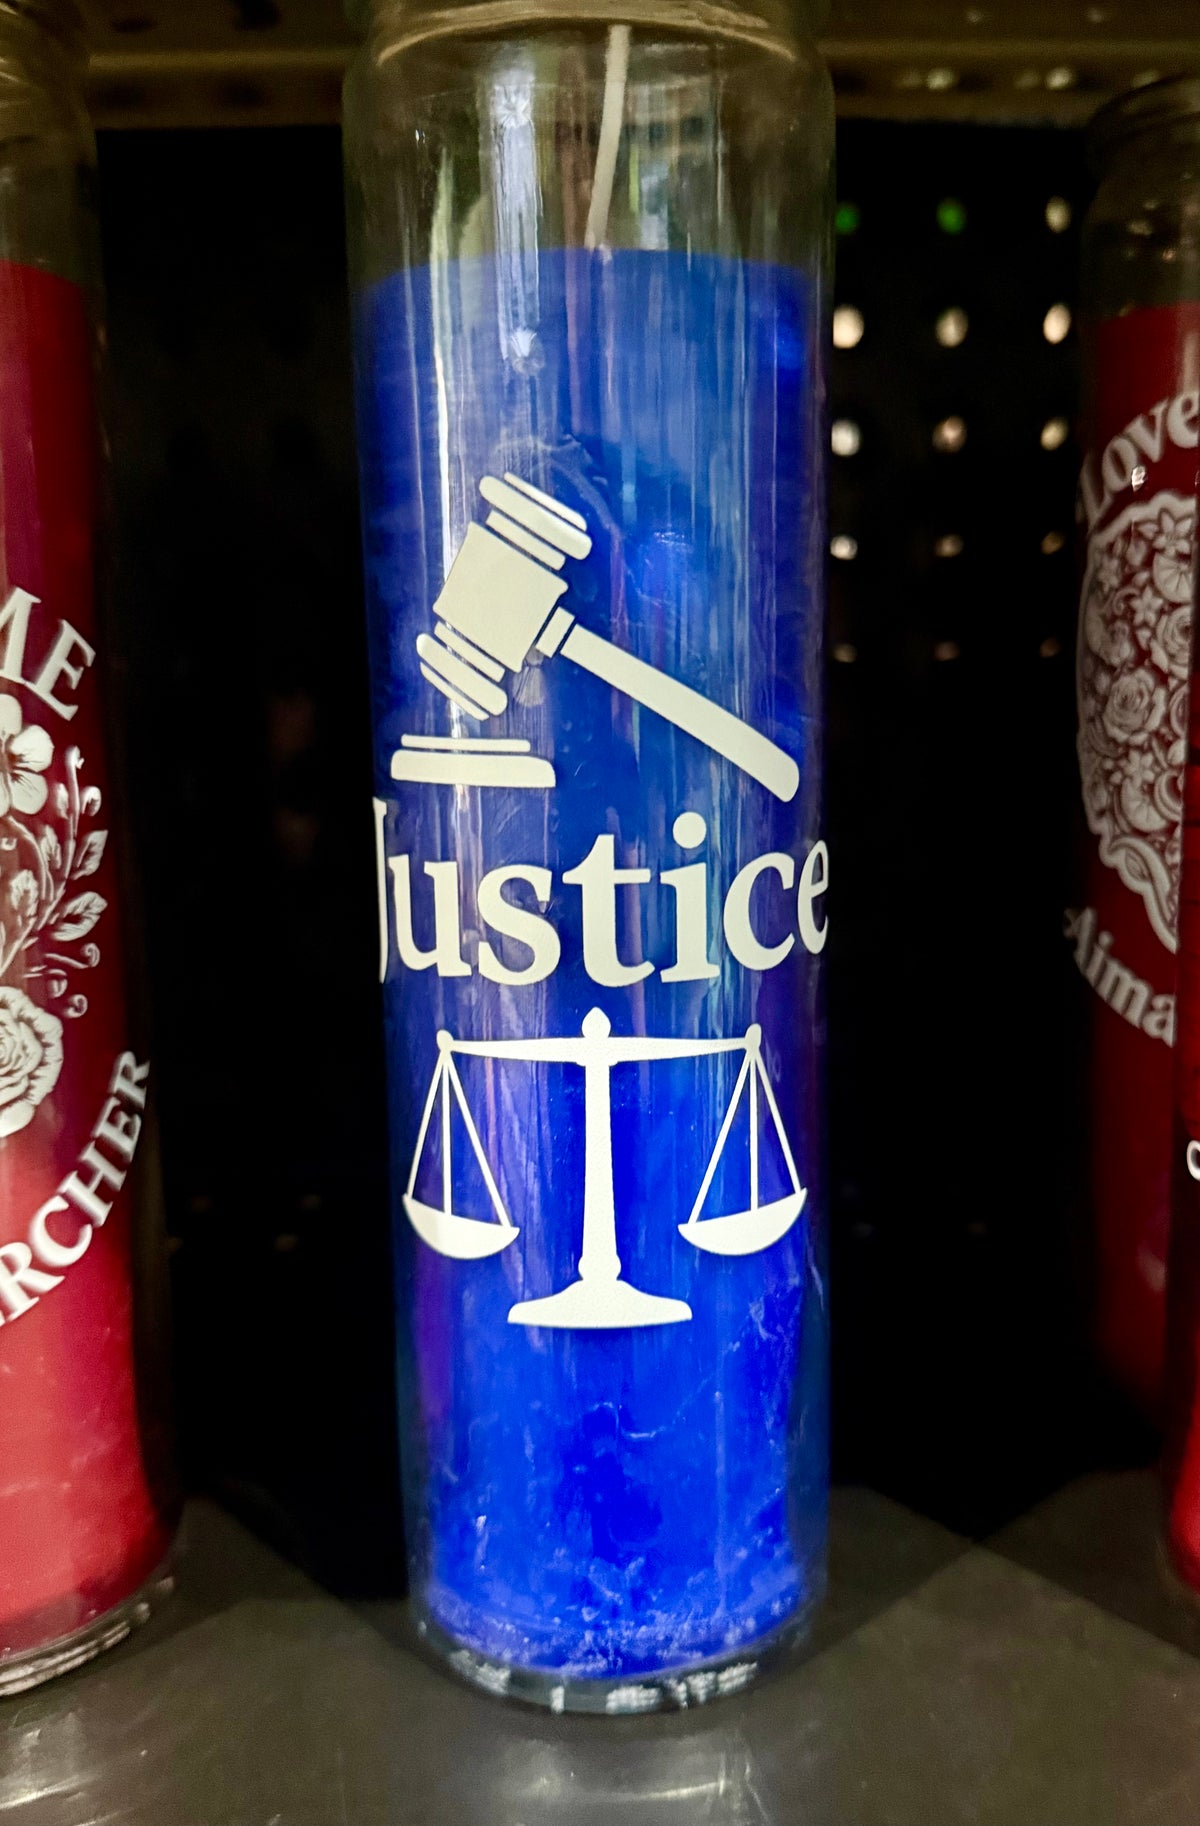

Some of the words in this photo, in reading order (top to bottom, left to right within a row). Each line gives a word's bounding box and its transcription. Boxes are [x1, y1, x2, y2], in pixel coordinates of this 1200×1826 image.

[1075, 391, 1200, 534] Love
[373, 797, 829, 987] Justice
[0, 1051, 150, 1327] RCHER
